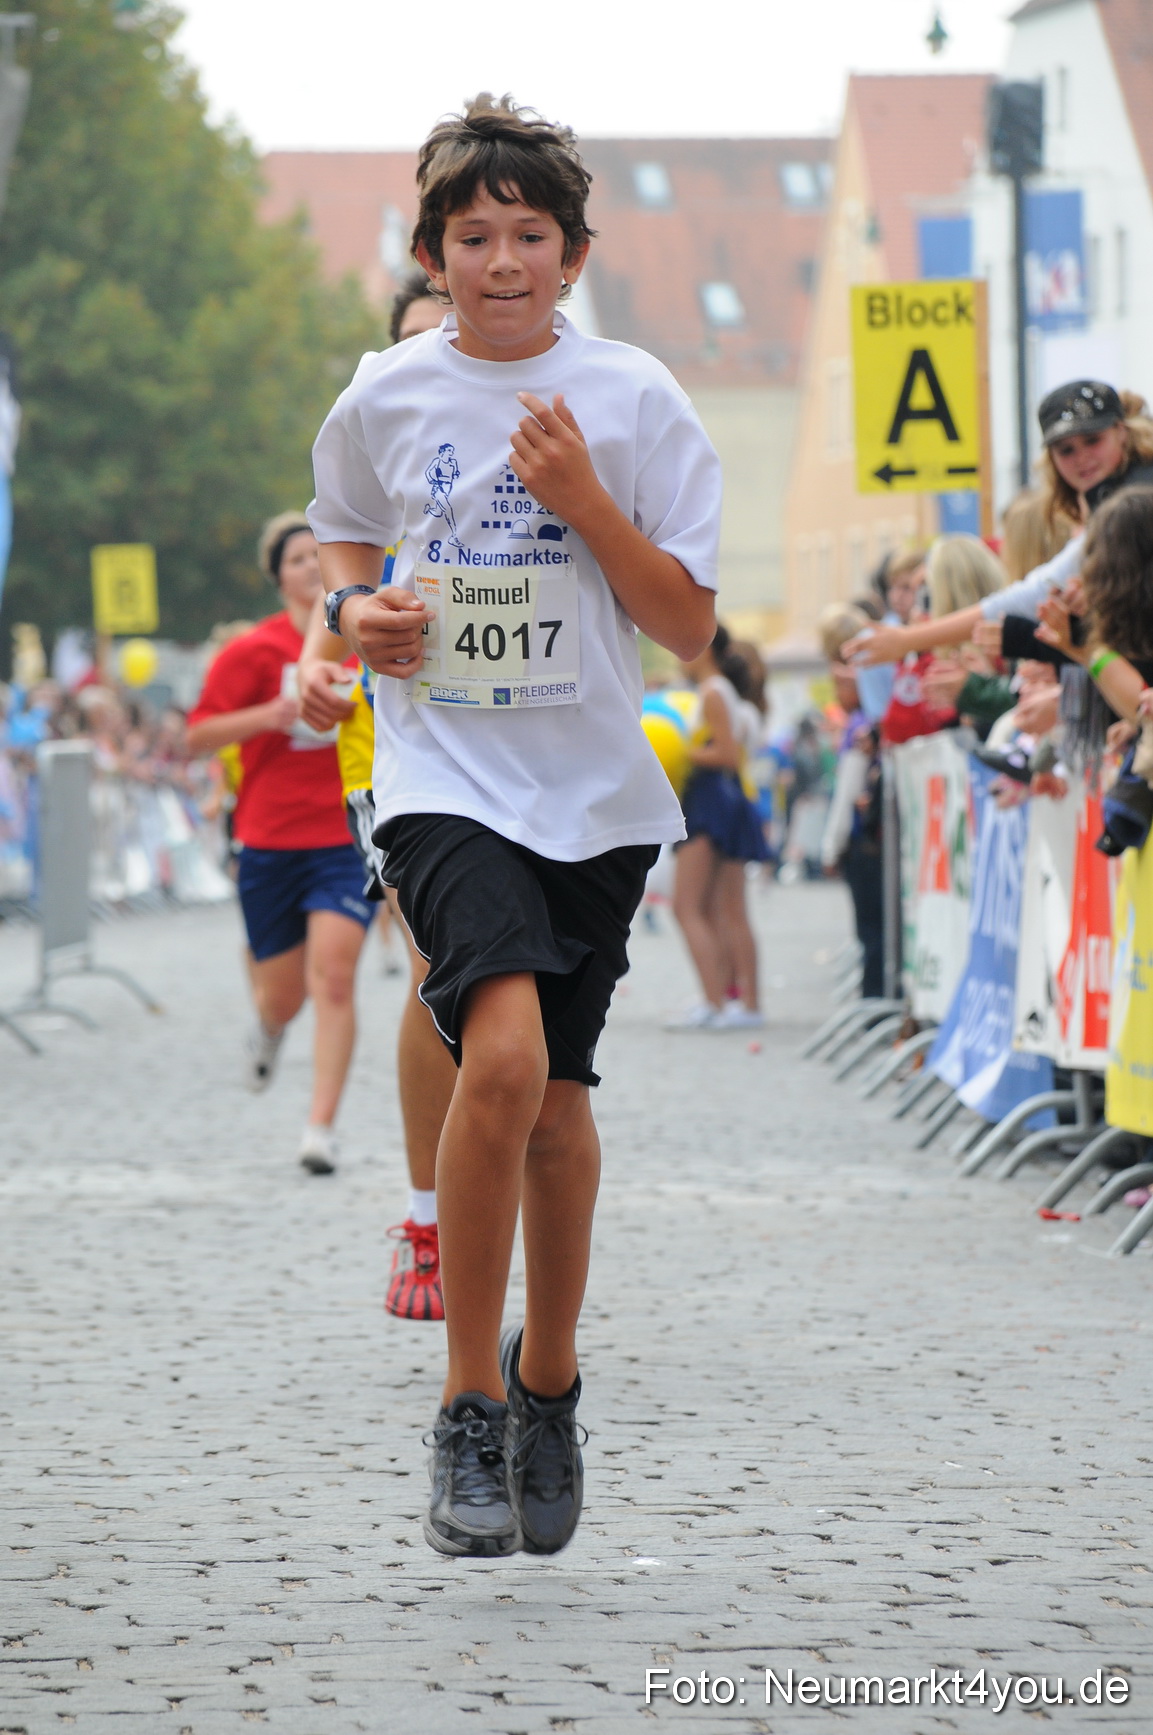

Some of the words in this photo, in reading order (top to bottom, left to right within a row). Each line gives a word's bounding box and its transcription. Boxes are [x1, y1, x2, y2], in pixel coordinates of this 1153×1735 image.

[867, 291, 974, 328] Block
[887, 348, 960, 444] A
[491, 500, 554, 515] 16.09.2
[427, 540, 450, 563] 8.
[458, 548, 570, 567] Neumarkter
[452, 577, 530, 605] Samuel
[455, 620, 563, 661] 4017
[430, 686, 469, 699] BOCK
[513, 683, 577, 698] PFLEIDERER
